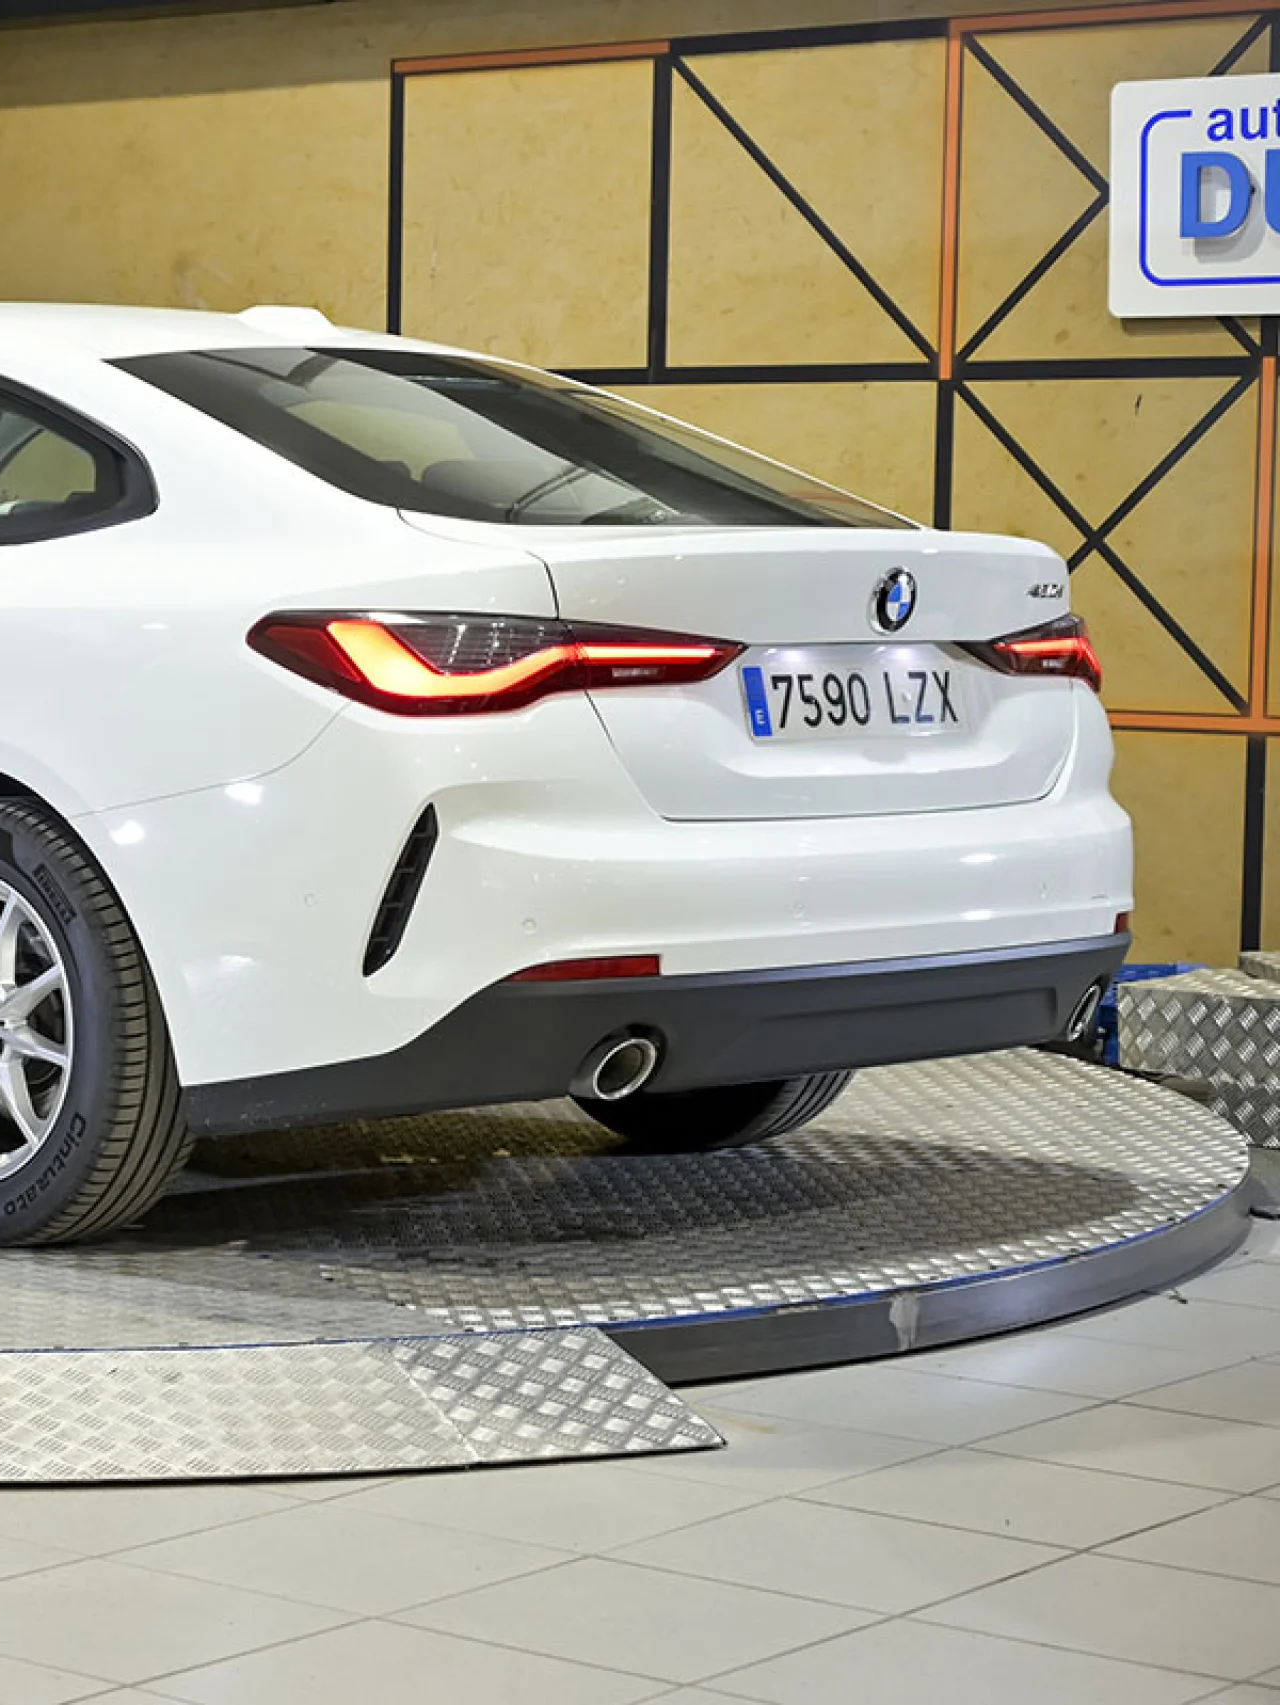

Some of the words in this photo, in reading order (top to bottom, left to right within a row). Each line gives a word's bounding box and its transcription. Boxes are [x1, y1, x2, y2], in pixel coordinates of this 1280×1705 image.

[1180, 148, 1280, 239] D
[754, 708, 766, 725] E
[771, 672, 871, 729] 7590
[883, 670, 959, 724] LZX
